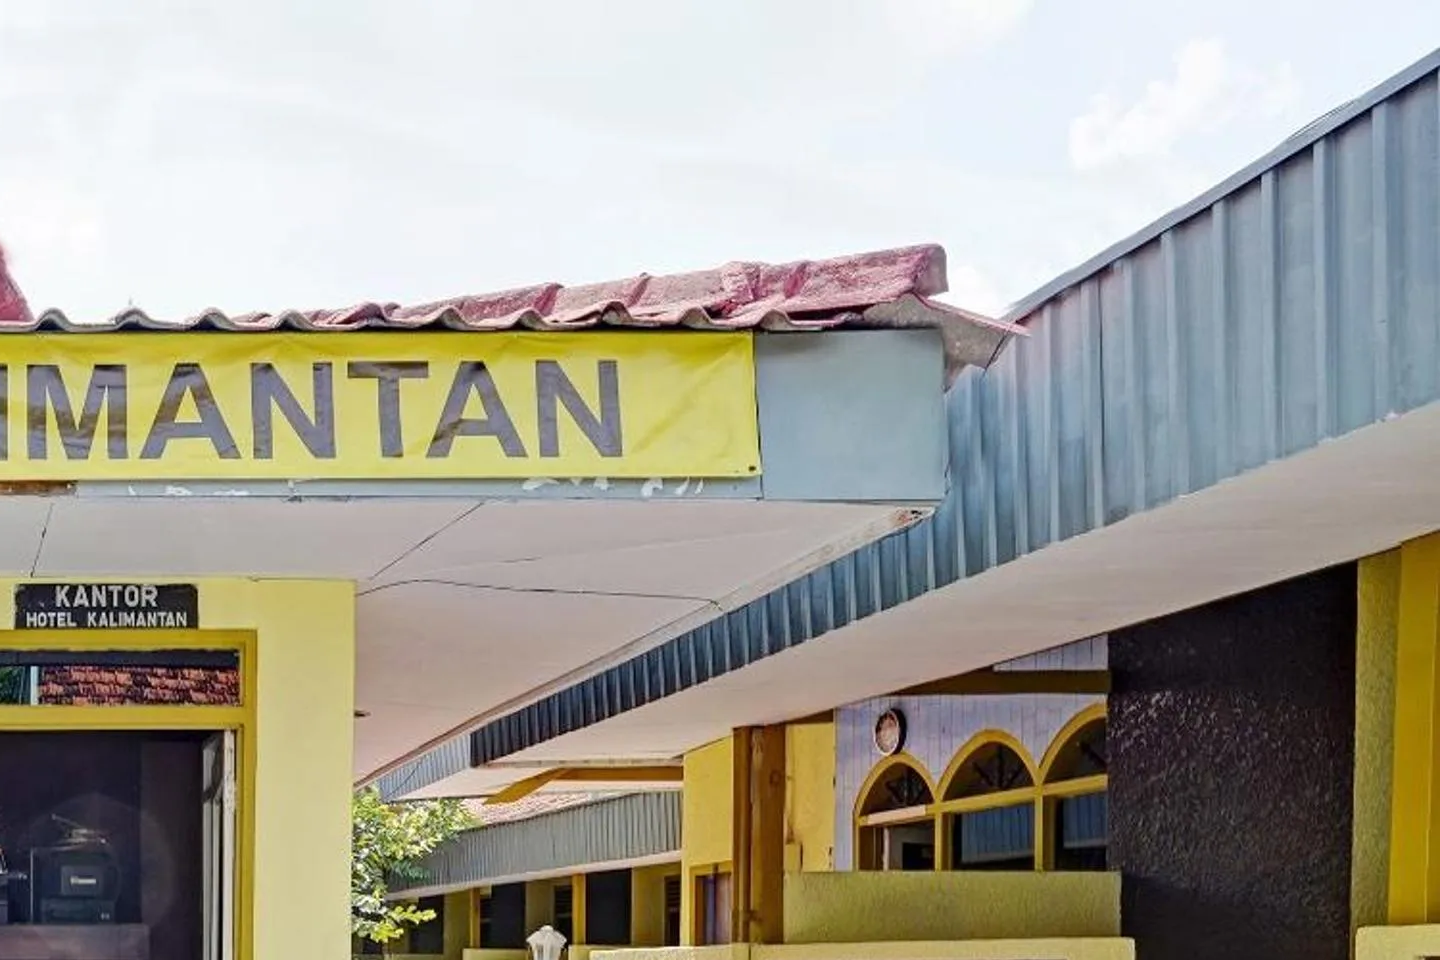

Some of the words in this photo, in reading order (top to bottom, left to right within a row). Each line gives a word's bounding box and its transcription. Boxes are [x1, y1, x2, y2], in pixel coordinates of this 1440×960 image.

[55, 585, 159, 608] KANTOR
[26, 612, 77, 627] HOTEL
[87, 611, 188, 627] KALIMANTAN
